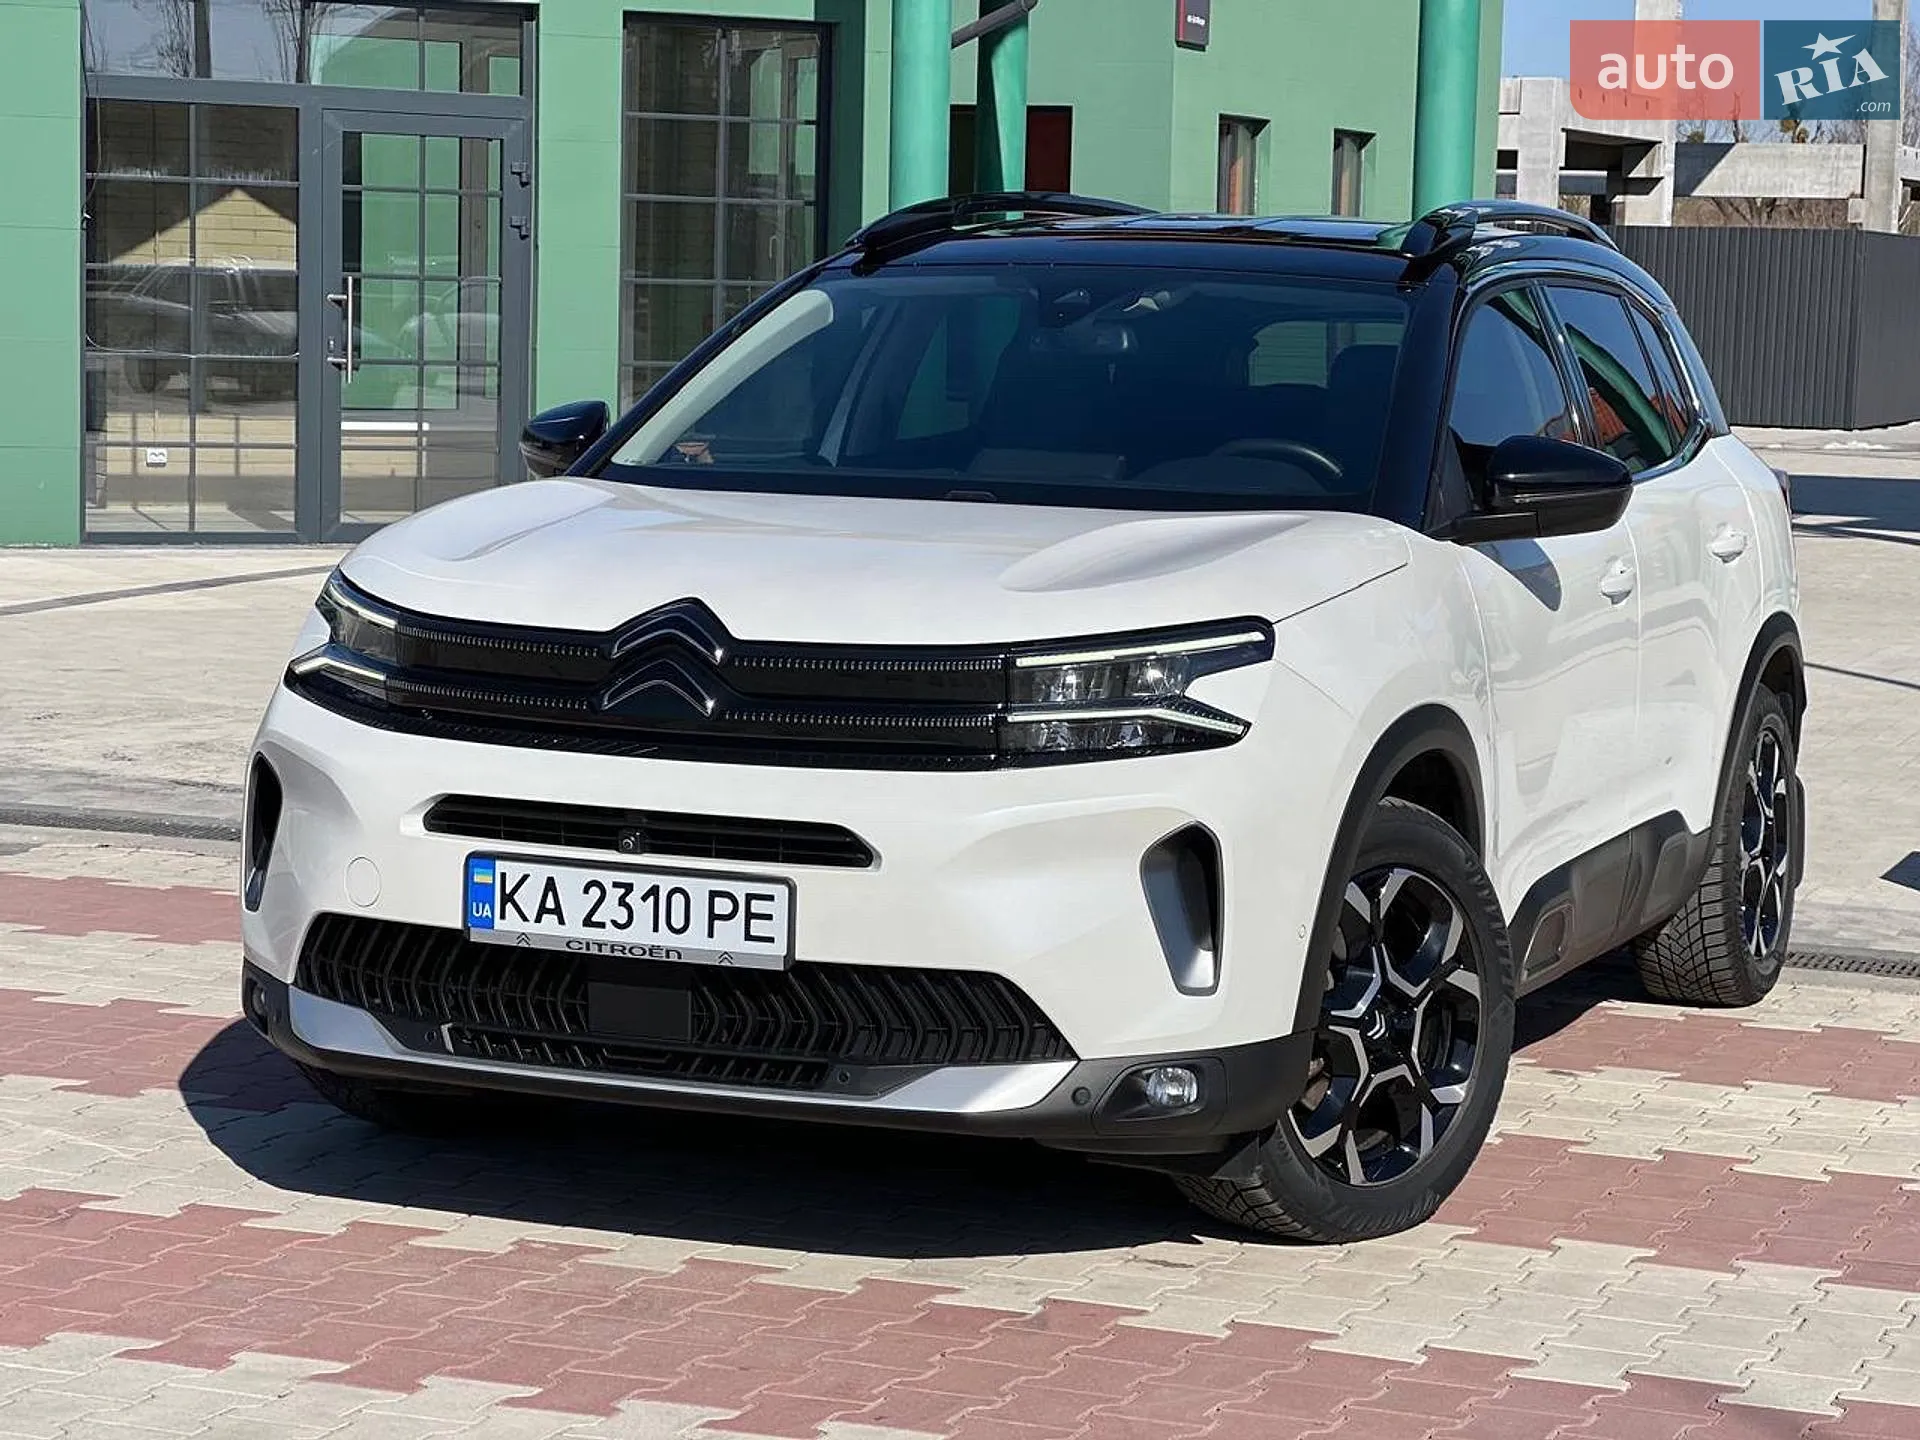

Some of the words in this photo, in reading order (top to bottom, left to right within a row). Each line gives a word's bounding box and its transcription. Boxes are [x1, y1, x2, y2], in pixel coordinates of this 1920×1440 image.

[472, 902, 492, 917] UA
[500, 872, 565, 926] KA
[582, 879, 691, 935] 2310
[707, 890, 775, 943] PE
